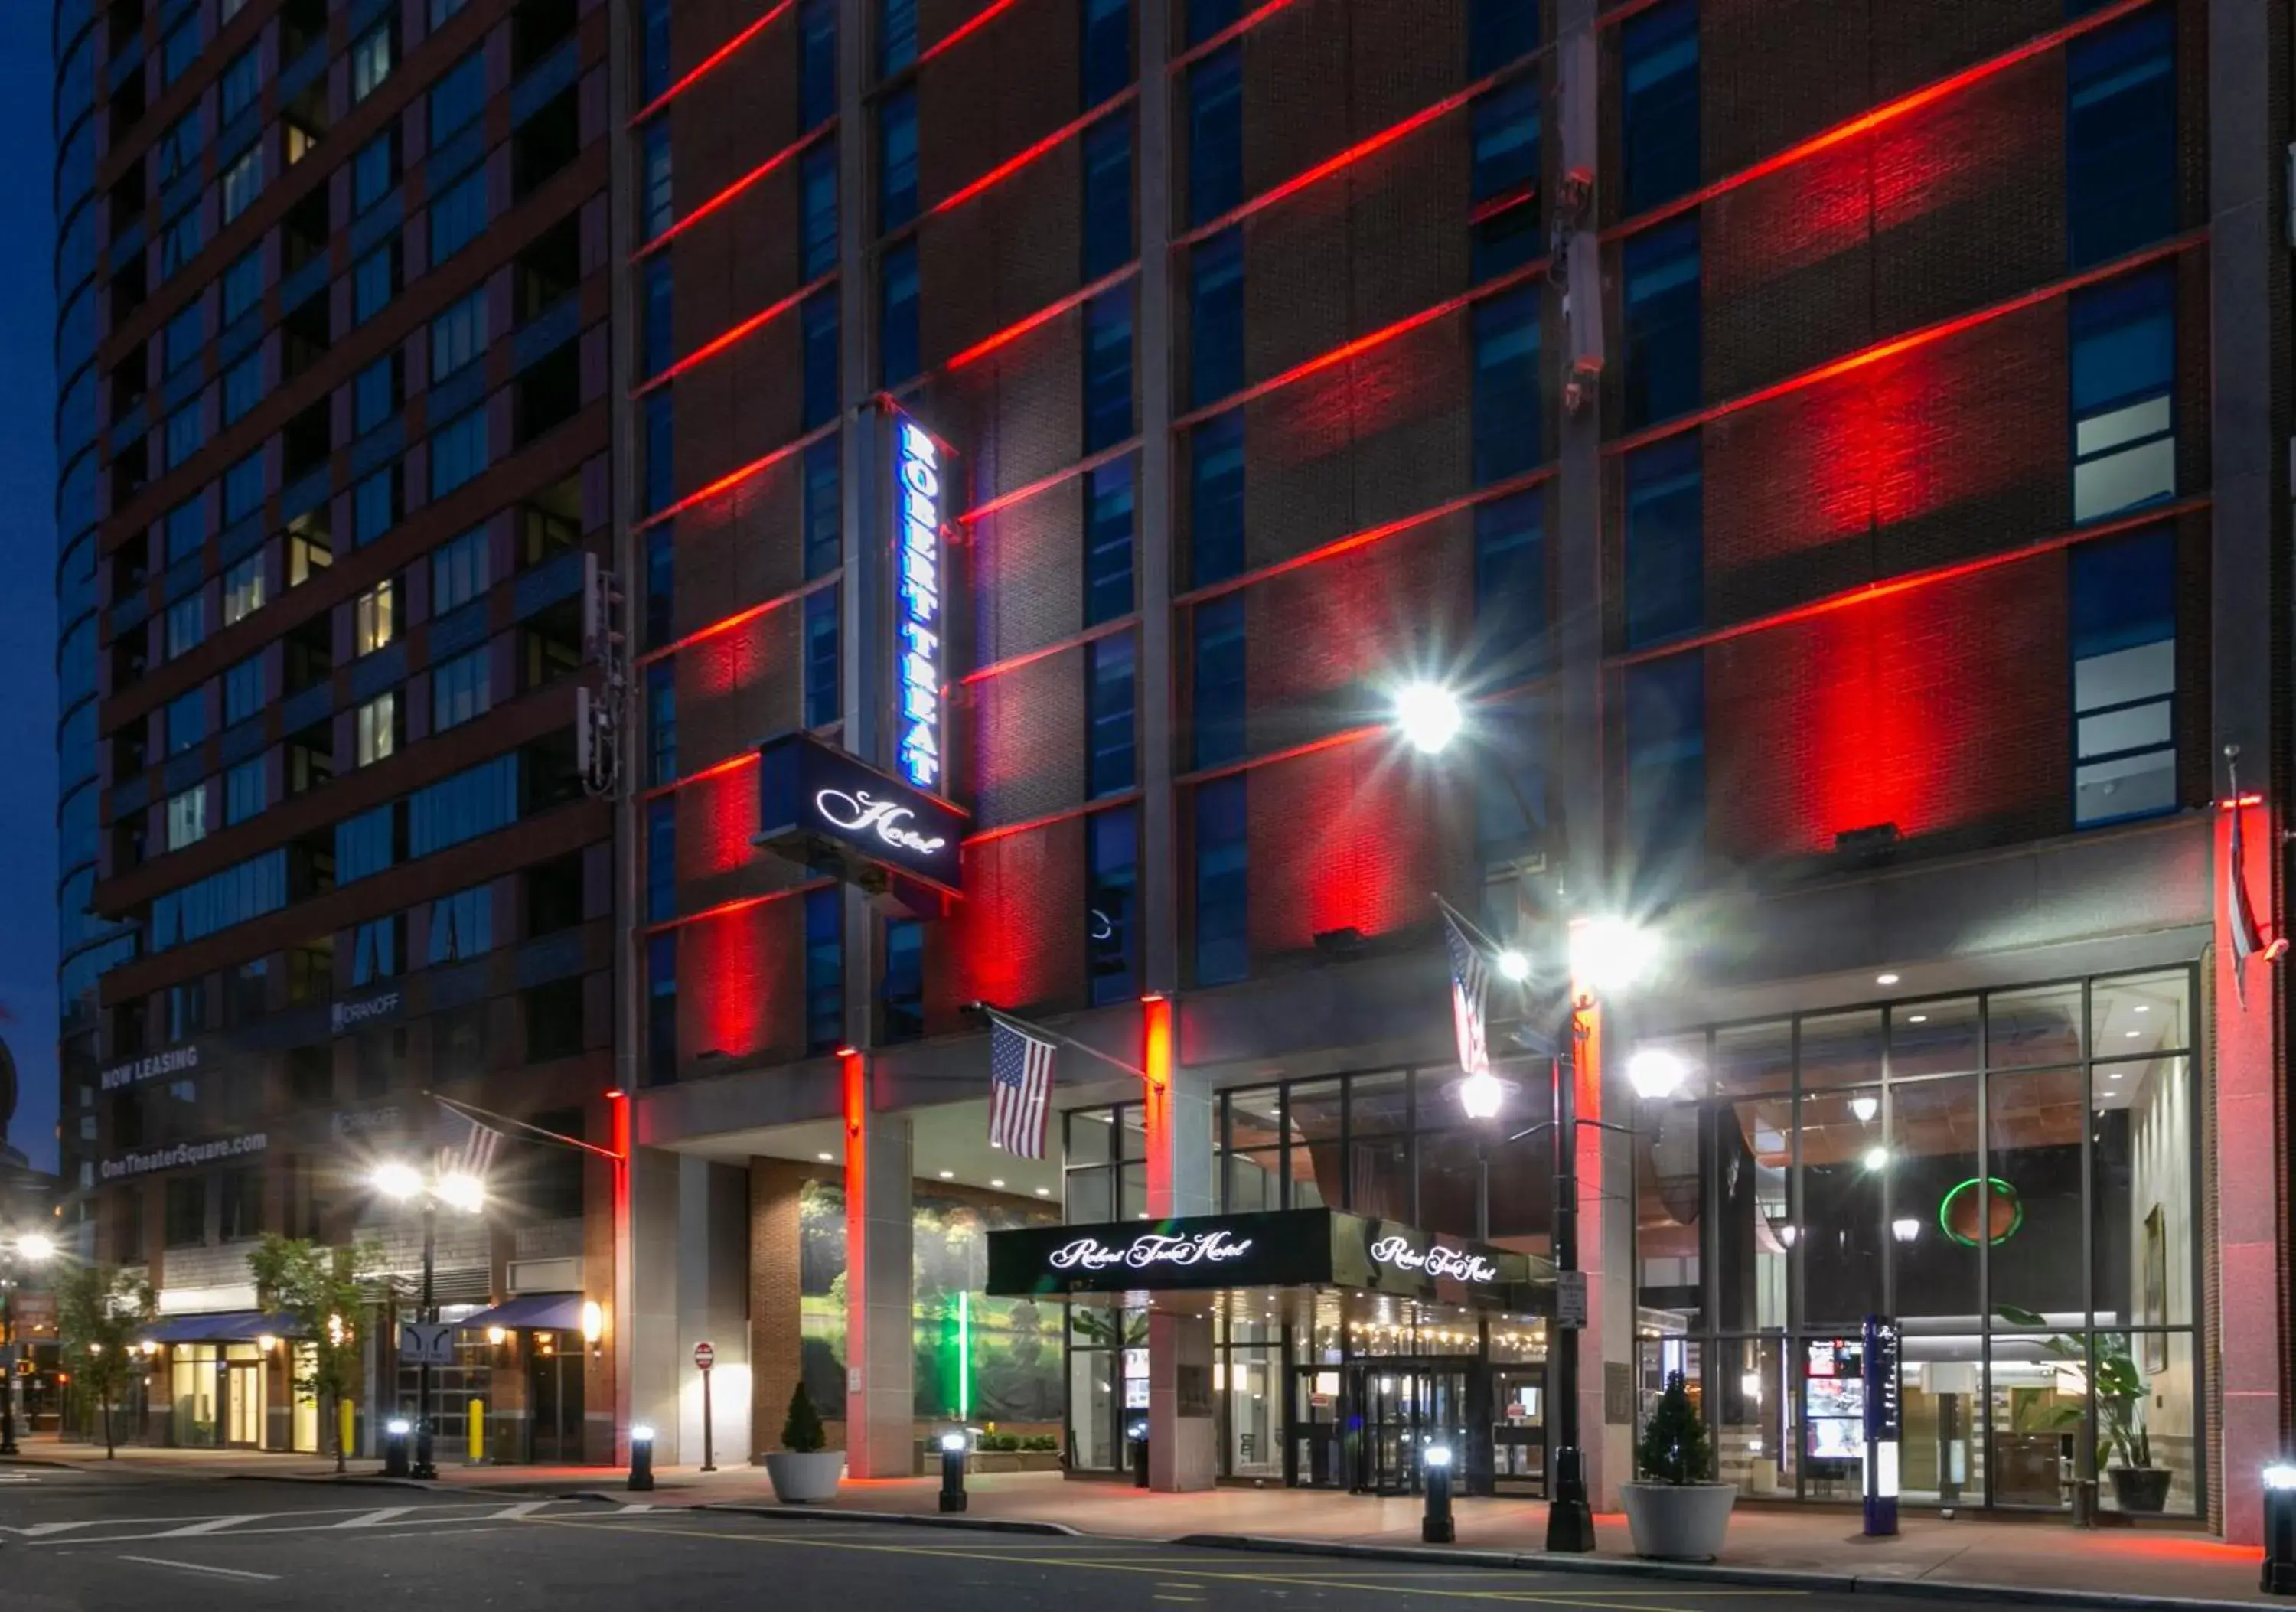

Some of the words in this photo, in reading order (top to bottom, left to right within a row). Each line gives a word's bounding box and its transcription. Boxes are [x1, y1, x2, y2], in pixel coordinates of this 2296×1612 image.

[902, 424, 938, 620] ROBERT
[902, 622, 938, 785] TREAT
[817, 789, 945, 854] Hotel
[102, 1065, 132, 1090] NOW
[135, 1046, 198, 1080] LEASING
[101, 1133, 267, 1179] OneTheaterSquare.com
[1049, 1238, 1127, 1269] Robert
[1127, 1233, 1189, 1268] Treat
[1172, 1231, 1253, 1265] Hotel
[1371, 1236, 1425, 1270] Robert
[1454, 1255, 1497, 1282] Hotel
